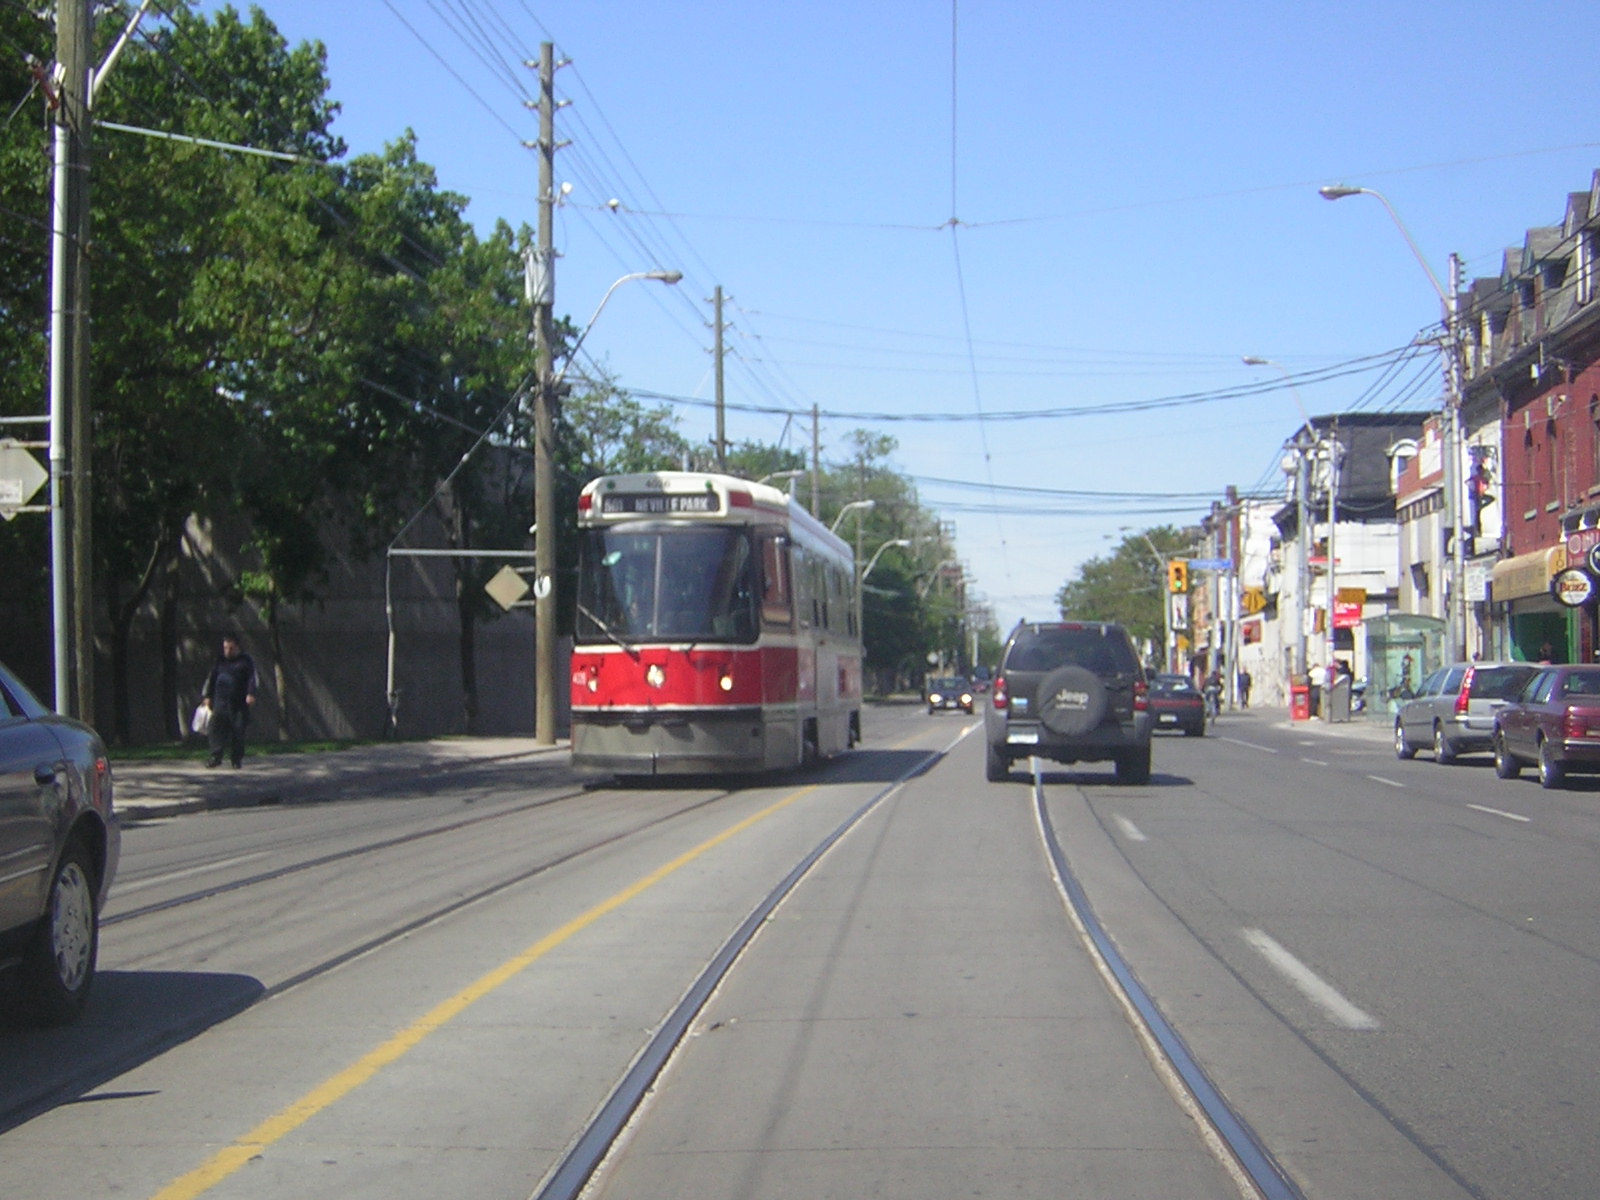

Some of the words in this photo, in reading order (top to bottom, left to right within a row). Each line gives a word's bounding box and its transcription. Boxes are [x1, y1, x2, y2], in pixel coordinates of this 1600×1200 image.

[635, 497, 679, 512] NEVILLE
[681, 496, 708, 512] PARK
[1056, 689, 1089, 705] Jeep
